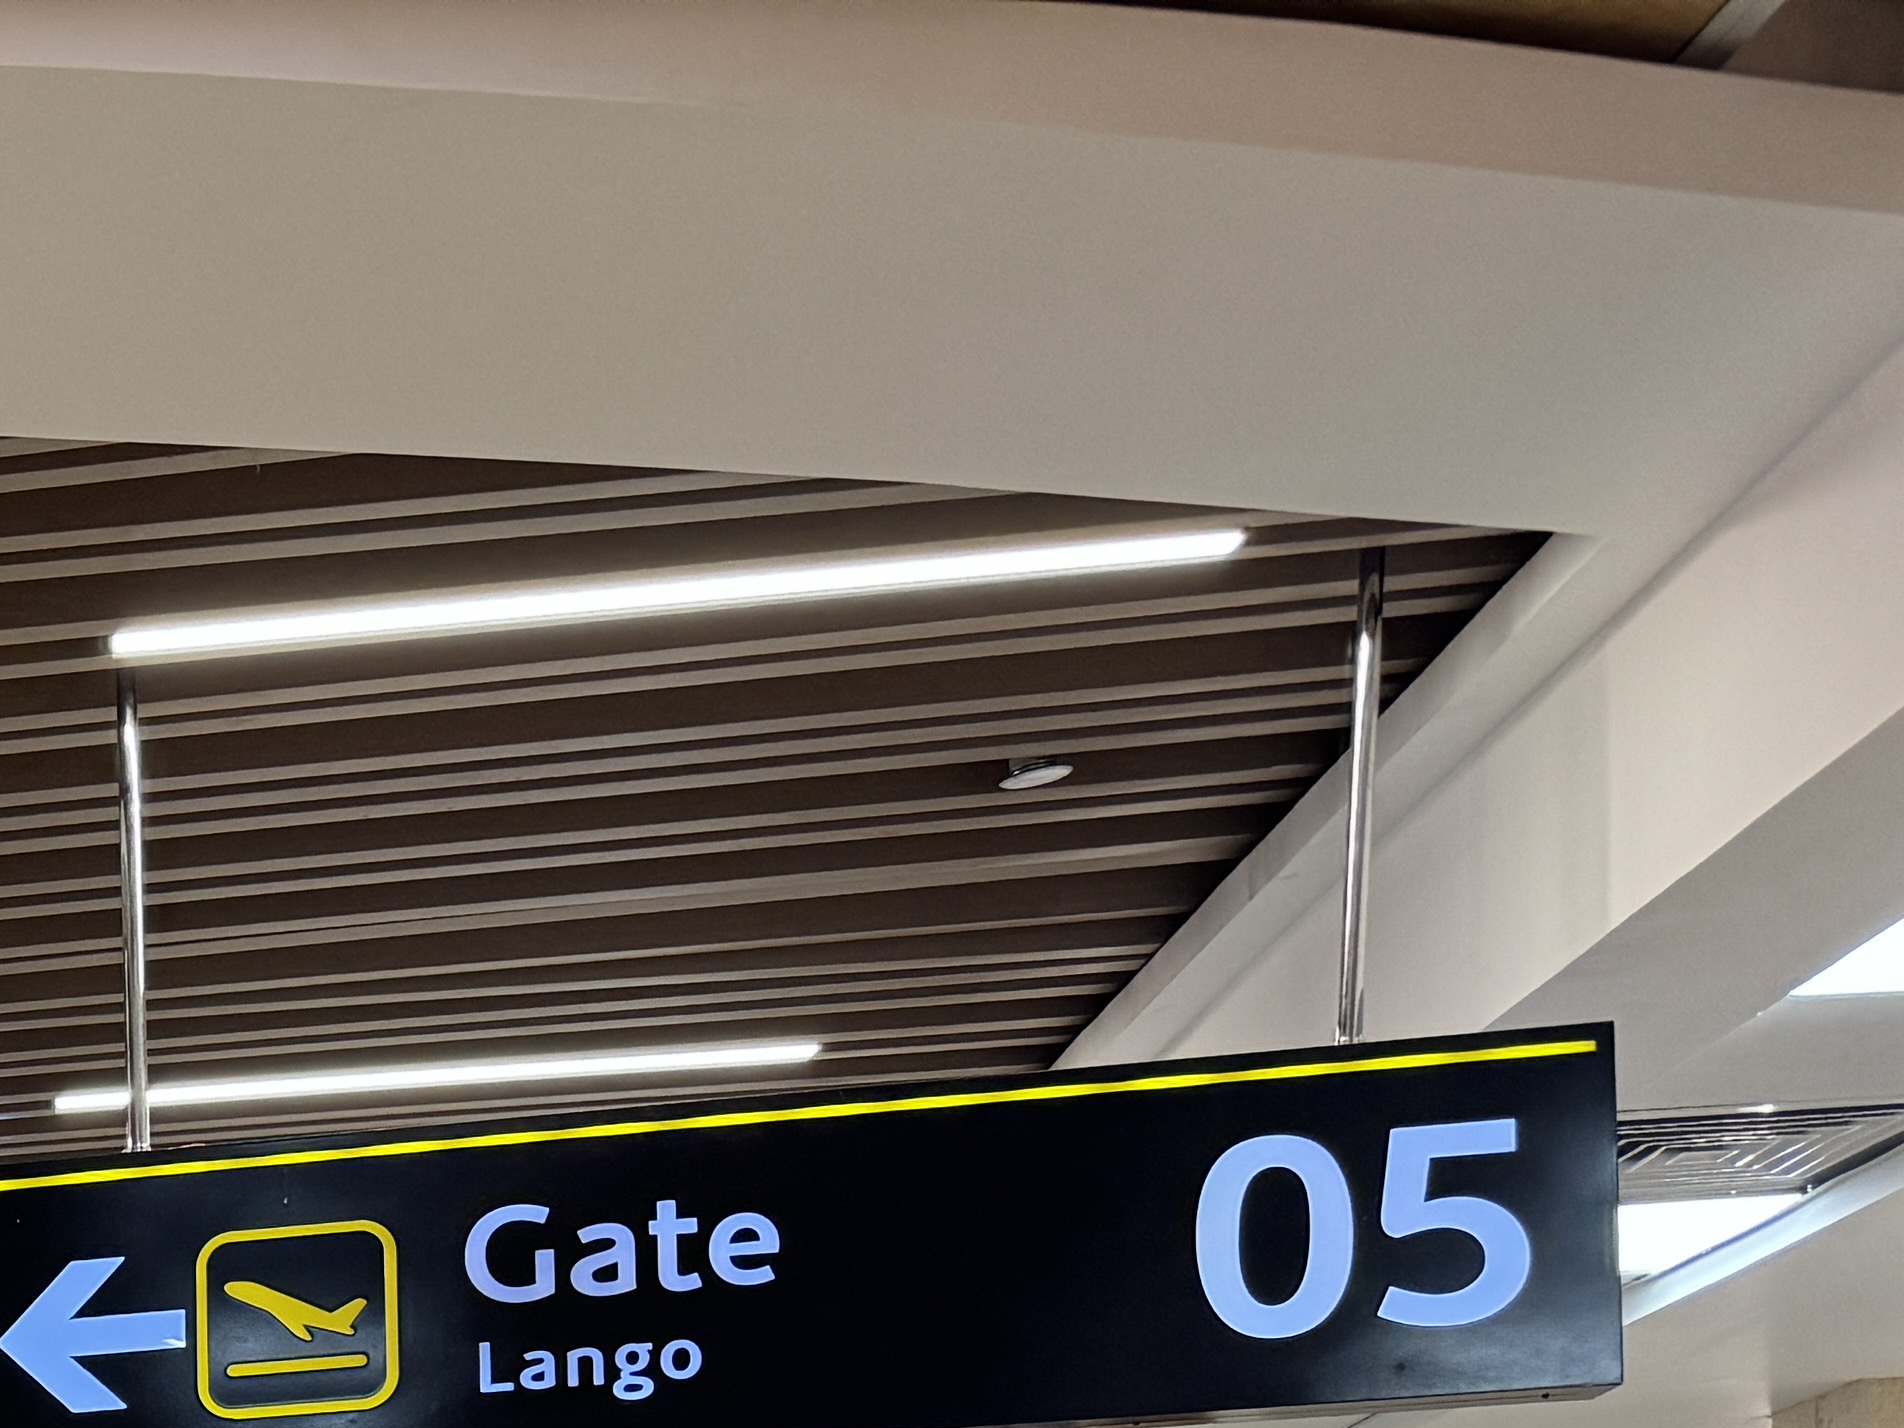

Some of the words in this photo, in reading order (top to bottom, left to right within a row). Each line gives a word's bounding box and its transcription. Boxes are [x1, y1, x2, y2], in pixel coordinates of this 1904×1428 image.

[465, 1200, 780, 1303] Gate
[1196, 1118, 1532, 1338] 05
[479, 1339, 702, 1400] Lango
